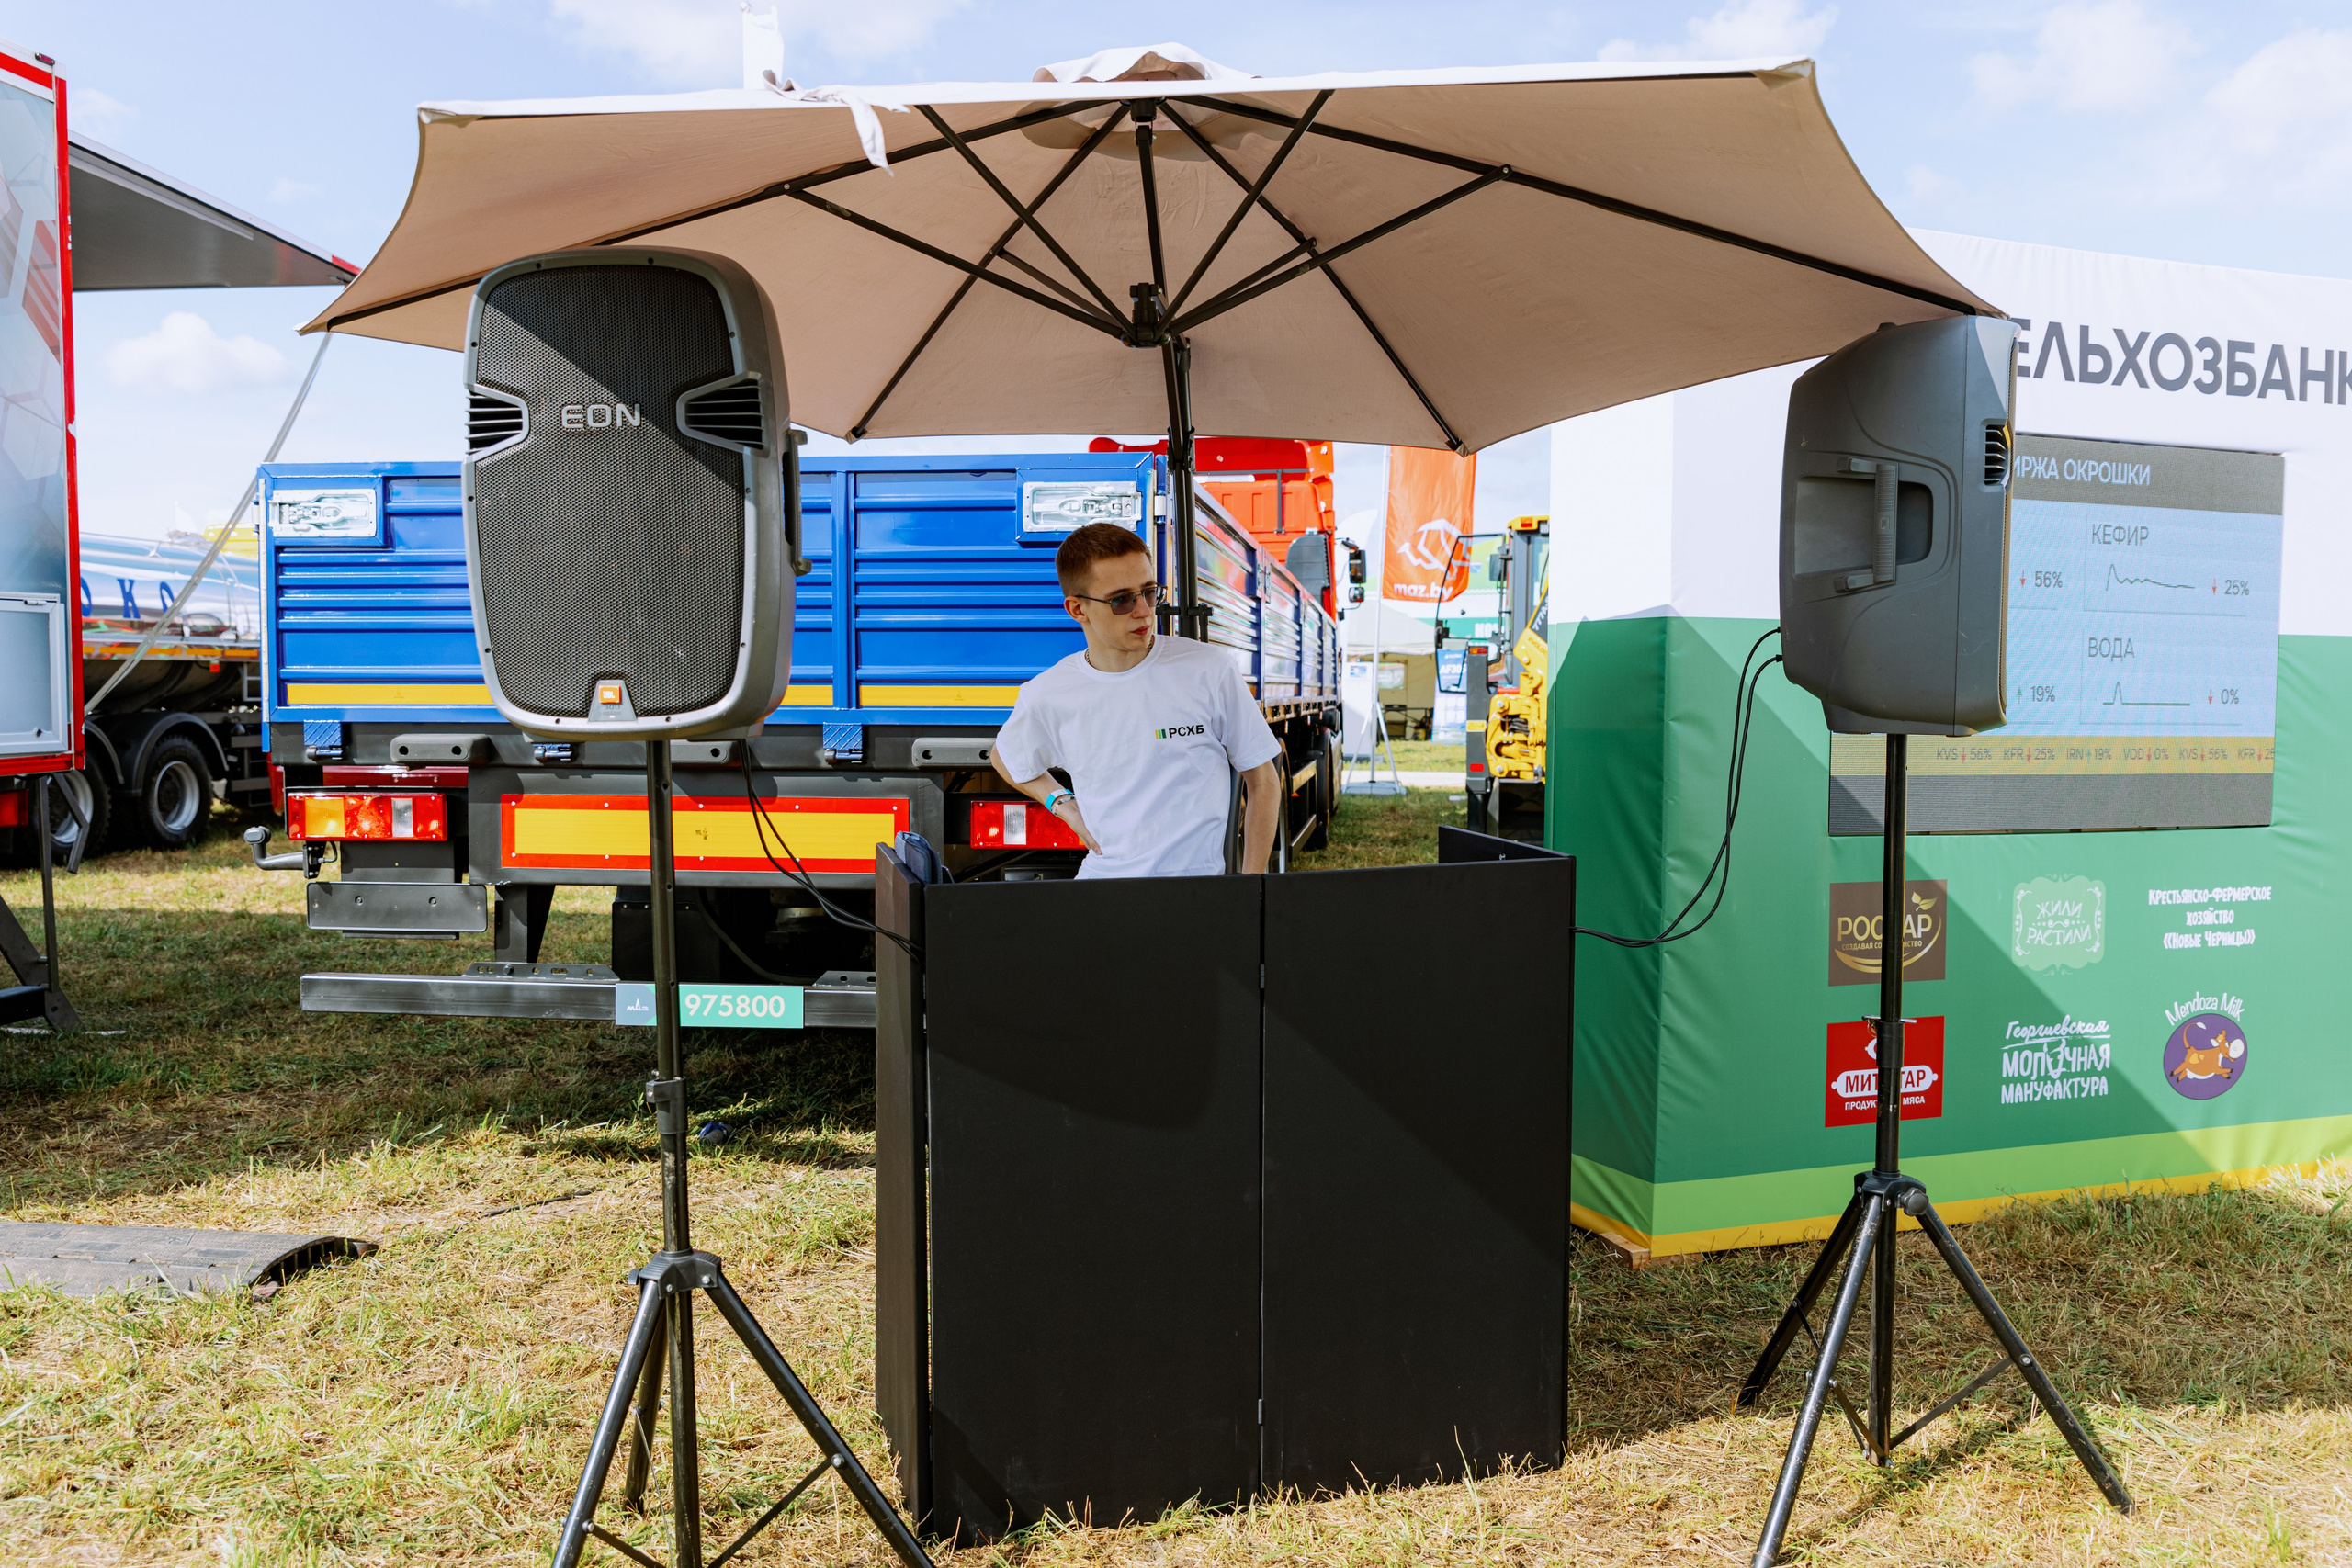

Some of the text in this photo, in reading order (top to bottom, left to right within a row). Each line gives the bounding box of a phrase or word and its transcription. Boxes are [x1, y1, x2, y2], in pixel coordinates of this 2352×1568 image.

[561, 403, 641, 428] EON
[2064, 458, 2151, 487] ОКРОШКИ
[2092, 523, 2149, 546] КЕФИР
[2034, 570, 2063, 588] 56%
[2224, 579, 2250, 595] 25%
[1393, 581, 1453, 601] maz.by
[2087, 637, 2135, 661] ВОДА
[2030, 685, 2055, 703] 19%
[2220, 688, 2239, 705] 0%
[1168, 724, 1204, 739] РСХБ
[2033, 747, 2055, 760] 25%
[2036, 899, 2083, 919] ЖИЛИ
[2186, 907, 2234, 926] ХОЗЯЙСТВО
[1838, 913, 1932, 942] РОСАР
[2025, 924, 2092, 946] РАСТИЛИ
[1841, 942, 1873, 951] СОЗДАВАЯ
[684, 994, 786, 1018] 975800
[2165, 991, 2245, 1026] Mendoza Milk
[2005, 1014, 2110, 1043] Георгиевская
[2002, 1042, 2110, 1080] МОЛОЧНАЯ
[2001, 1076, 2109, 1104] МАНУФАКТУРА
[1844, 1096, 1926, 1111] ПРОДУК МЯСА
